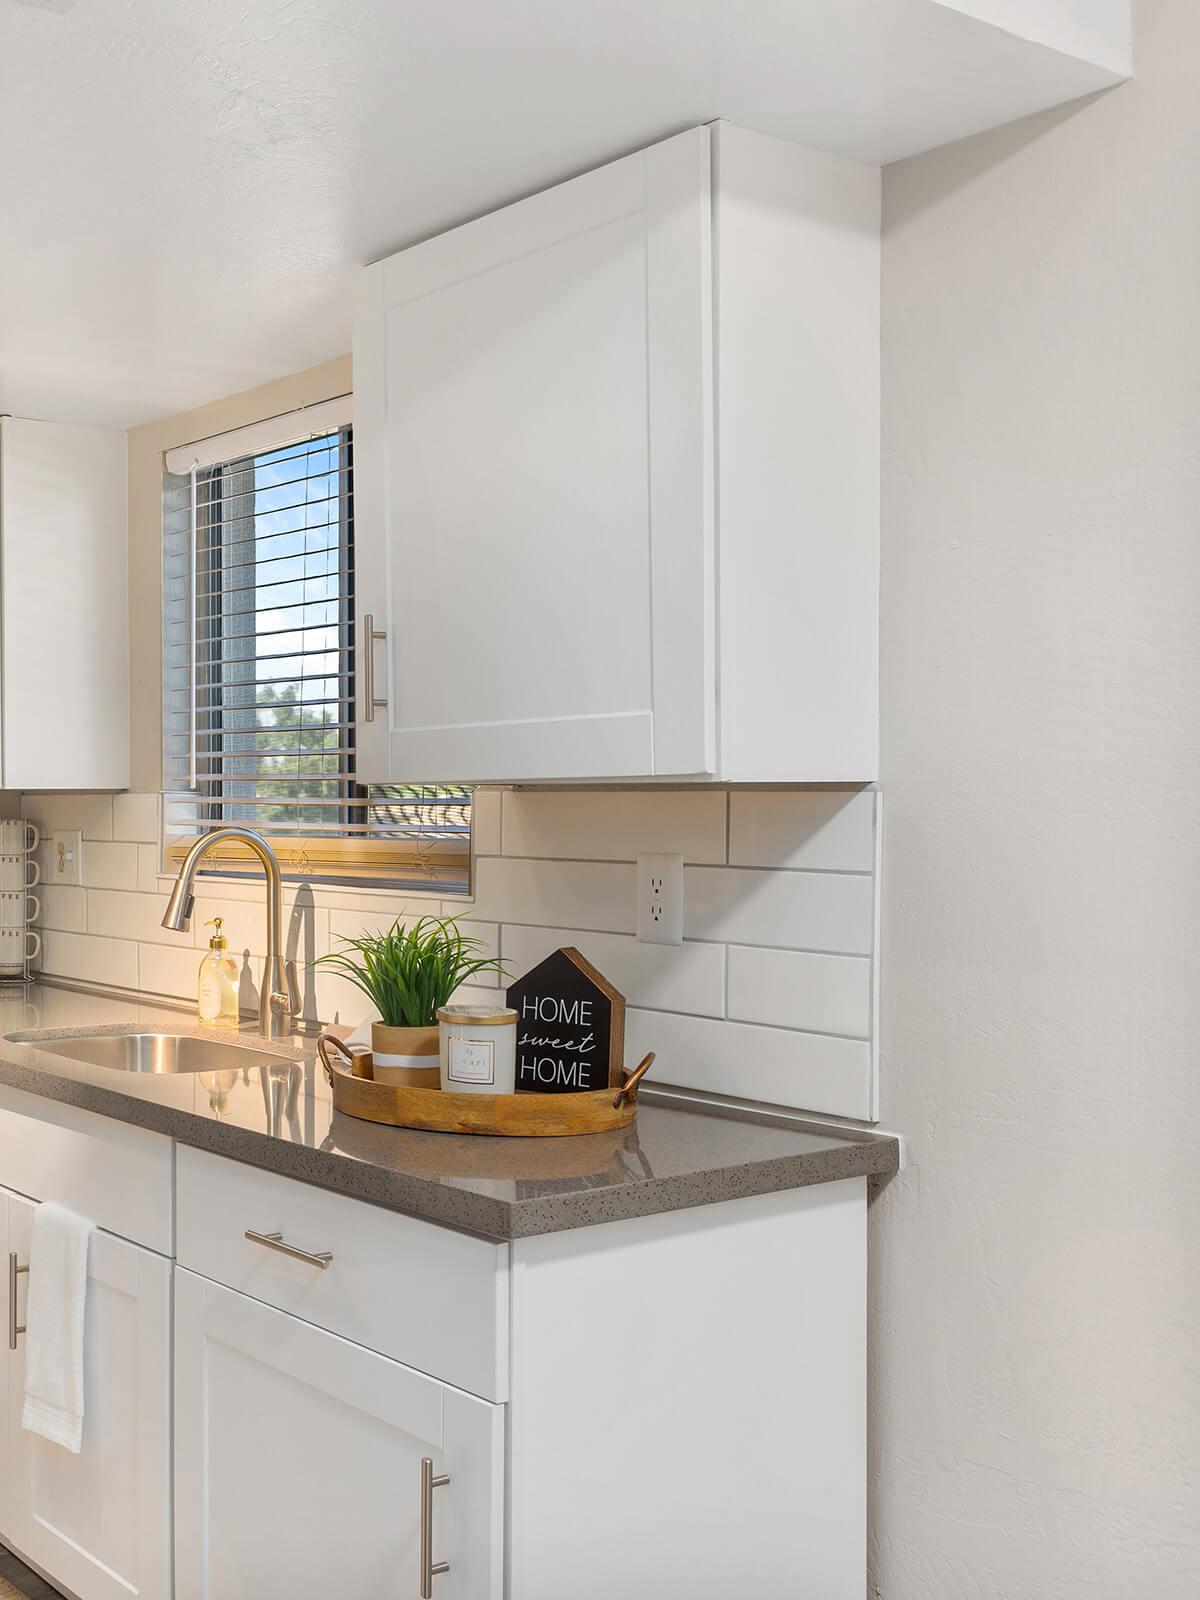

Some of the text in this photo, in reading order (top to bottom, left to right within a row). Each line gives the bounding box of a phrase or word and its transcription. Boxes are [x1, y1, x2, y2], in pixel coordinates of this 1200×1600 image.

[522, 995, 593, 1026] HOME
[518, 1032, 596, 1053] sweet
[520, 1055, 592, 1088] HOME
